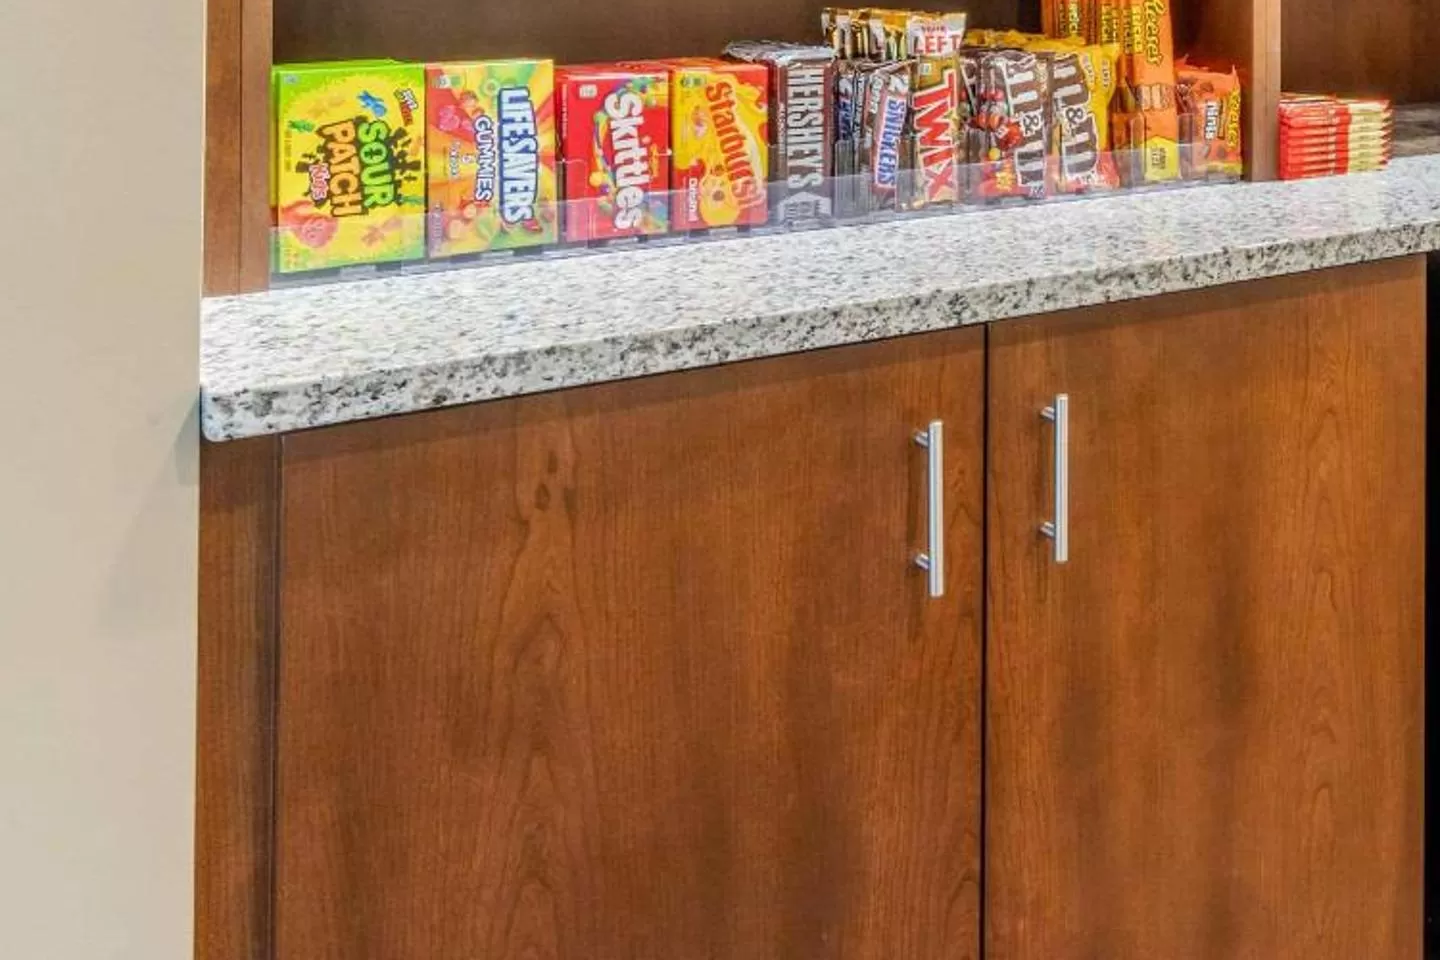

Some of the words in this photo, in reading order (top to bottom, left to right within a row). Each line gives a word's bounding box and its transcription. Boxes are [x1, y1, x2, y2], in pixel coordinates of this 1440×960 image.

[913, 33, 963, 56] LEFT
[318, 120, 363, 217] PATCH
[357, 120, 395, 209] SOUR
[474, 115, 494, 201] GUMMIES
[604, 92, 651, 230] Skittles
[705, 82, 766, 210] Starburst
[786, 68, 825, 189] HERSHEY'S
[876, 98, 907, 187] SNICKERS
[913, 68, 959, 202] TWIX
